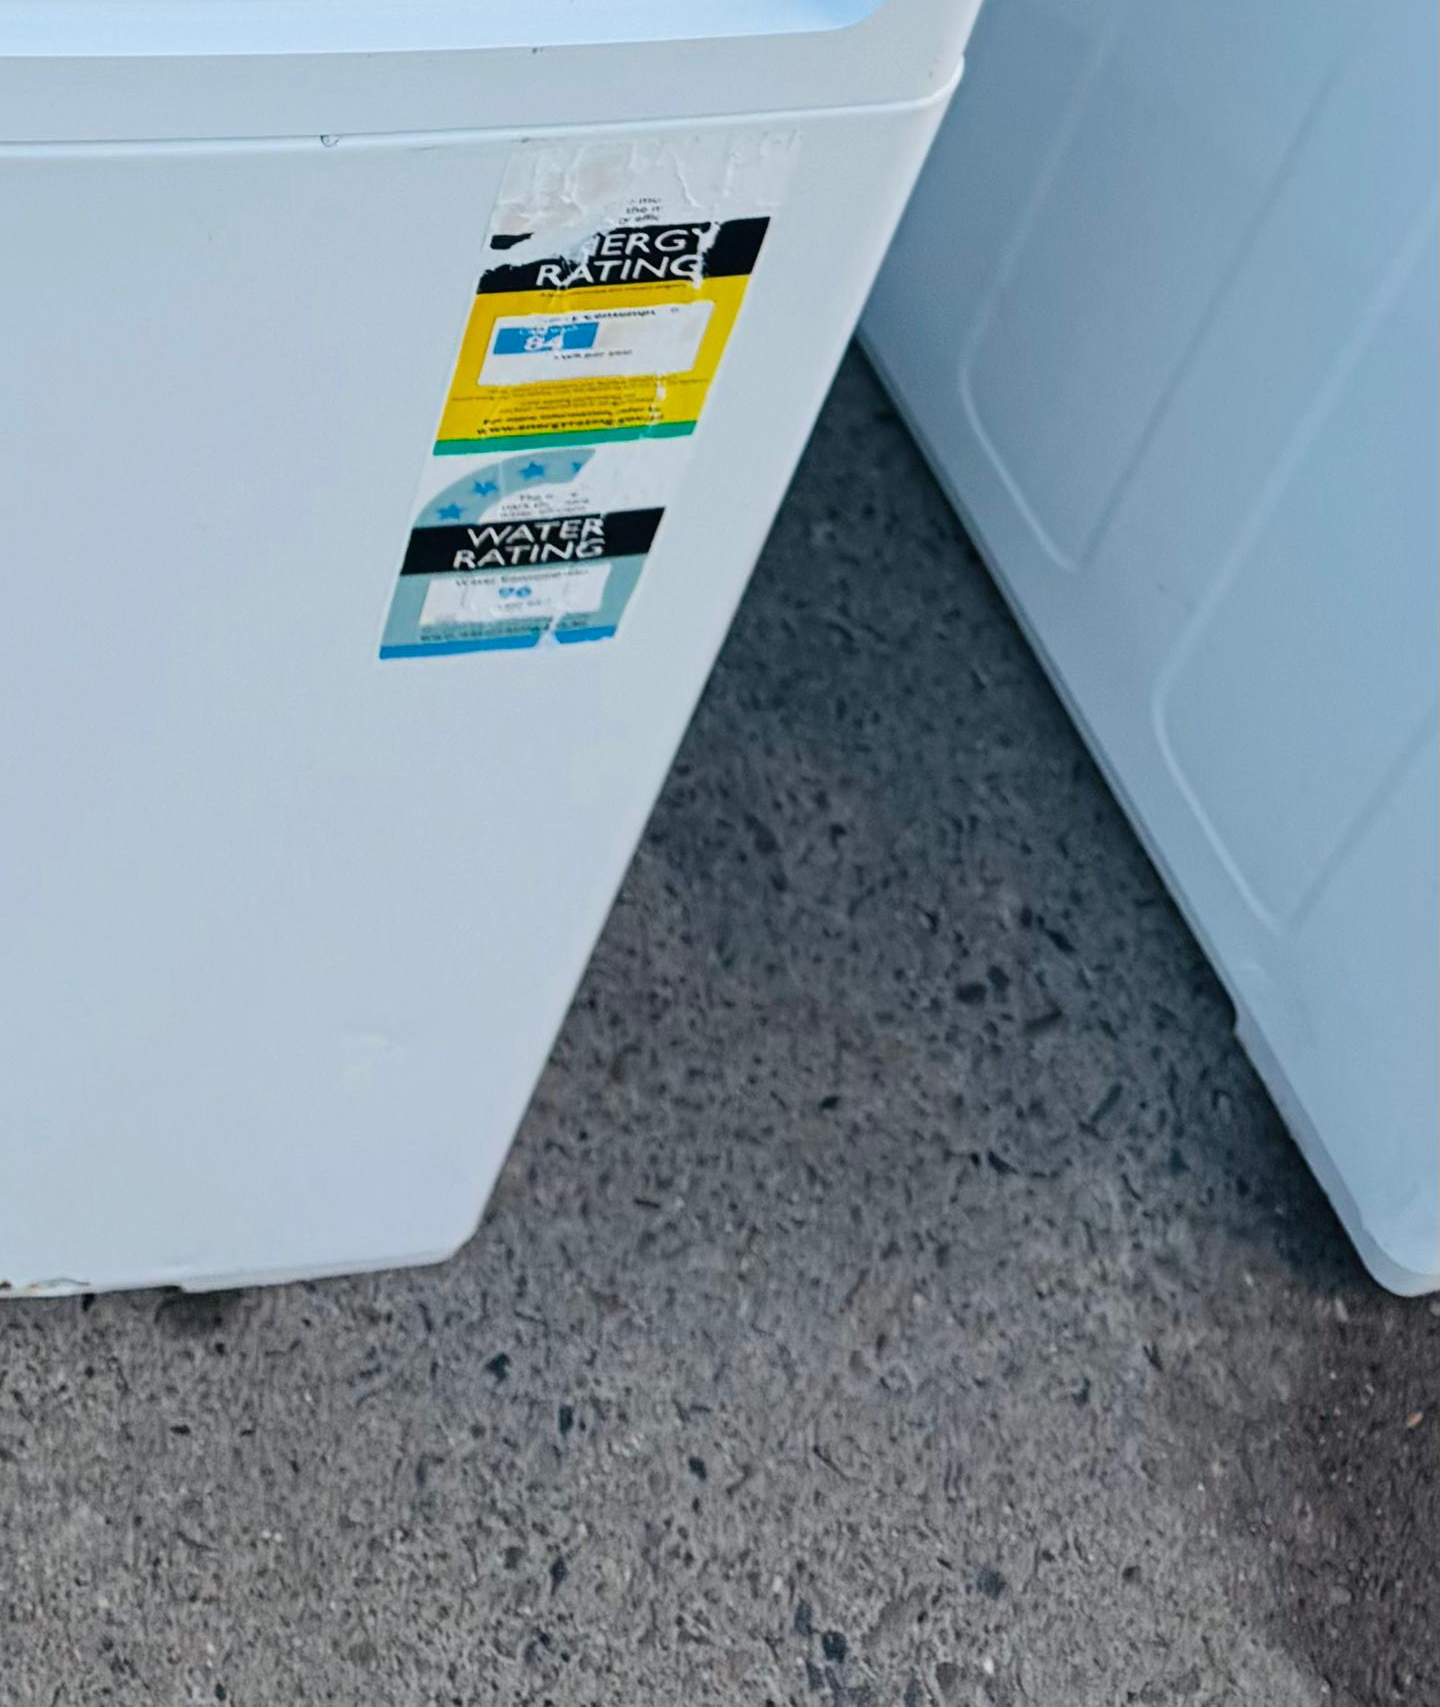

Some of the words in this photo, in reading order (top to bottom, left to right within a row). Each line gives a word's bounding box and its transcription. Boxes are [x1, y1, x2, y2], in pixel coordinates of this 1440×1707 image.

[591, 224, 719, 257] ERGY
[536, 254, 704, 287] RATING
[467, 518, 606, 549] WATER
[453, 538, 606, 570] RATING
